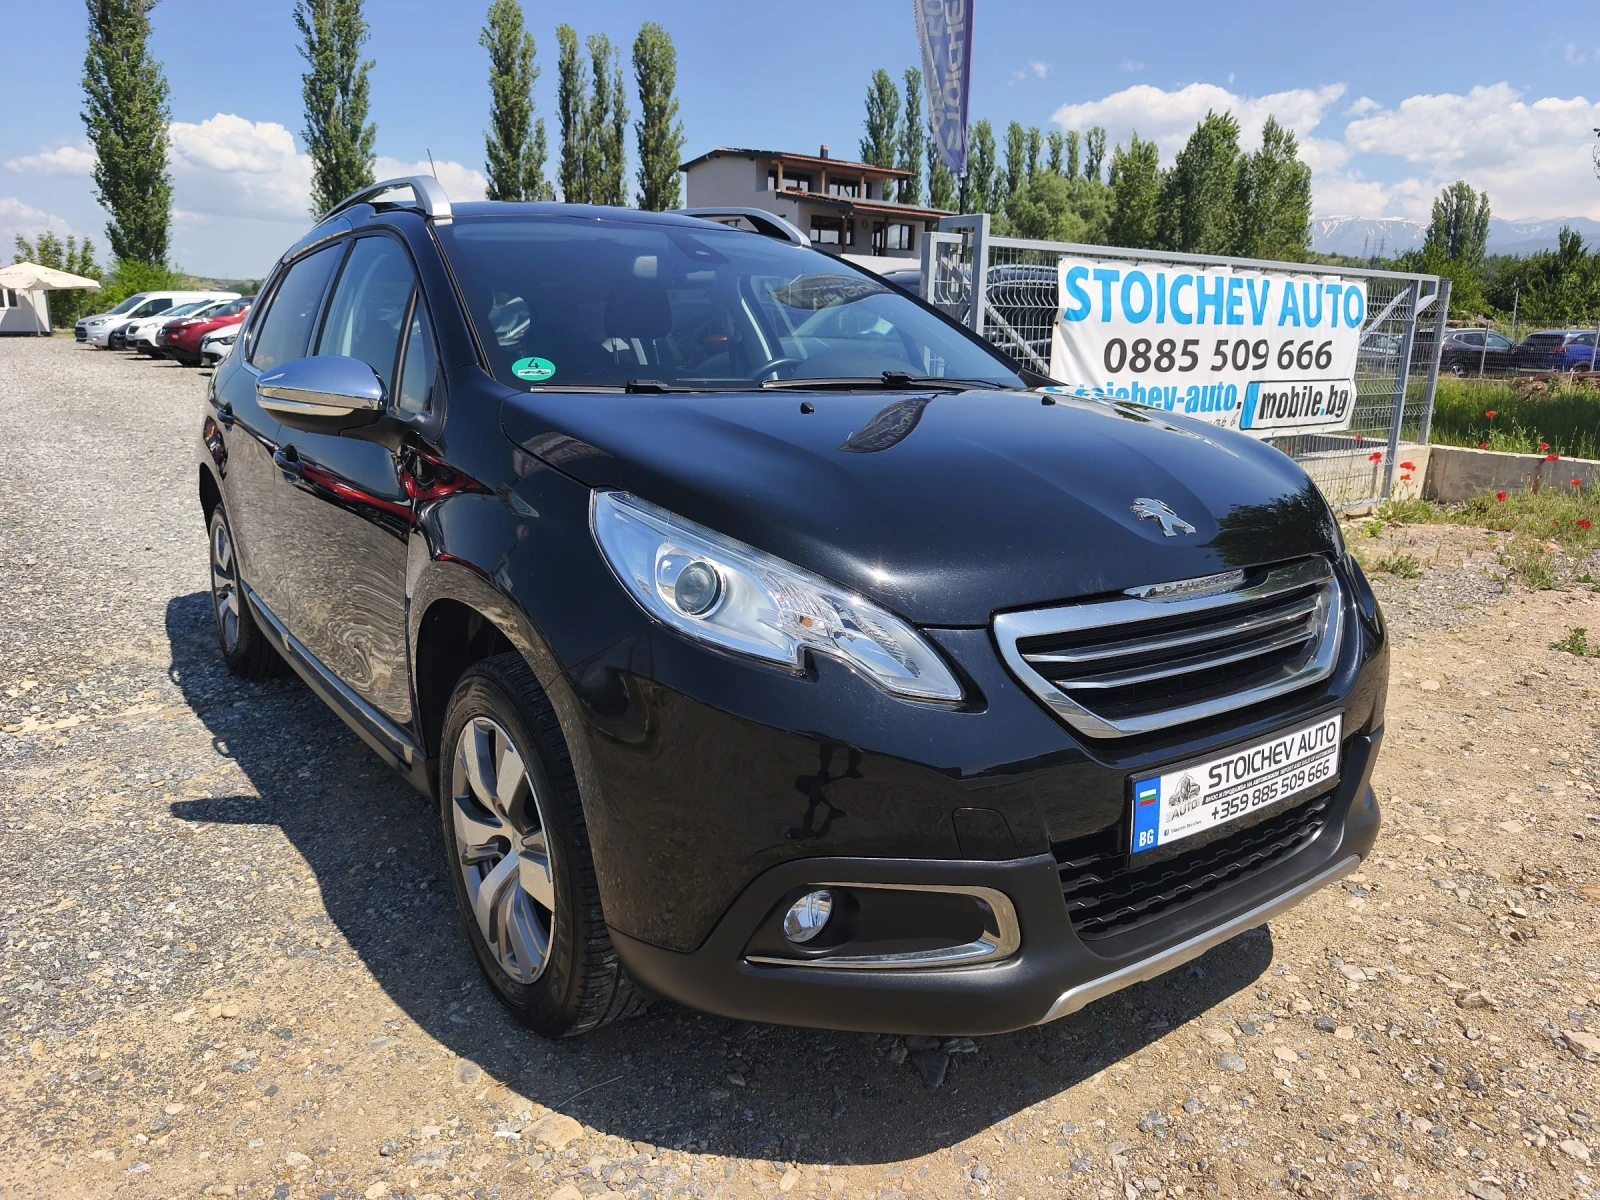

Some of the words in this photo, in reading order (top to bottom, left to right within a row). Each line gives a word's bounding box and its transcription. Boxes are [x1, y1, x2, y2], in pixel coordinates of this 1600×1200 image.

[1063, 266, 1270, 325] STOICHEV
[1278, 281, 1364, 329] AUTO
[527, 358, 540, 369] 4
[1103, 338, 1200, 374] 0885
[1210, 339, 1269, 372] 509
[1277, 340, 1332, 370] 666
[1258, 385, 1348, 420] mobile.bg
[1208, 737, 1295, 789] STOICHEV
[1296, 721, 1336, 756] AUTO
[1211, 794, 1249, 820] +359
[1251, 781, 1279, 807] 885
[1280, 770, 1305, 796] 509
[1307, 758, 1330, 783] 666
[1138, 828, 1155, 847] BG
